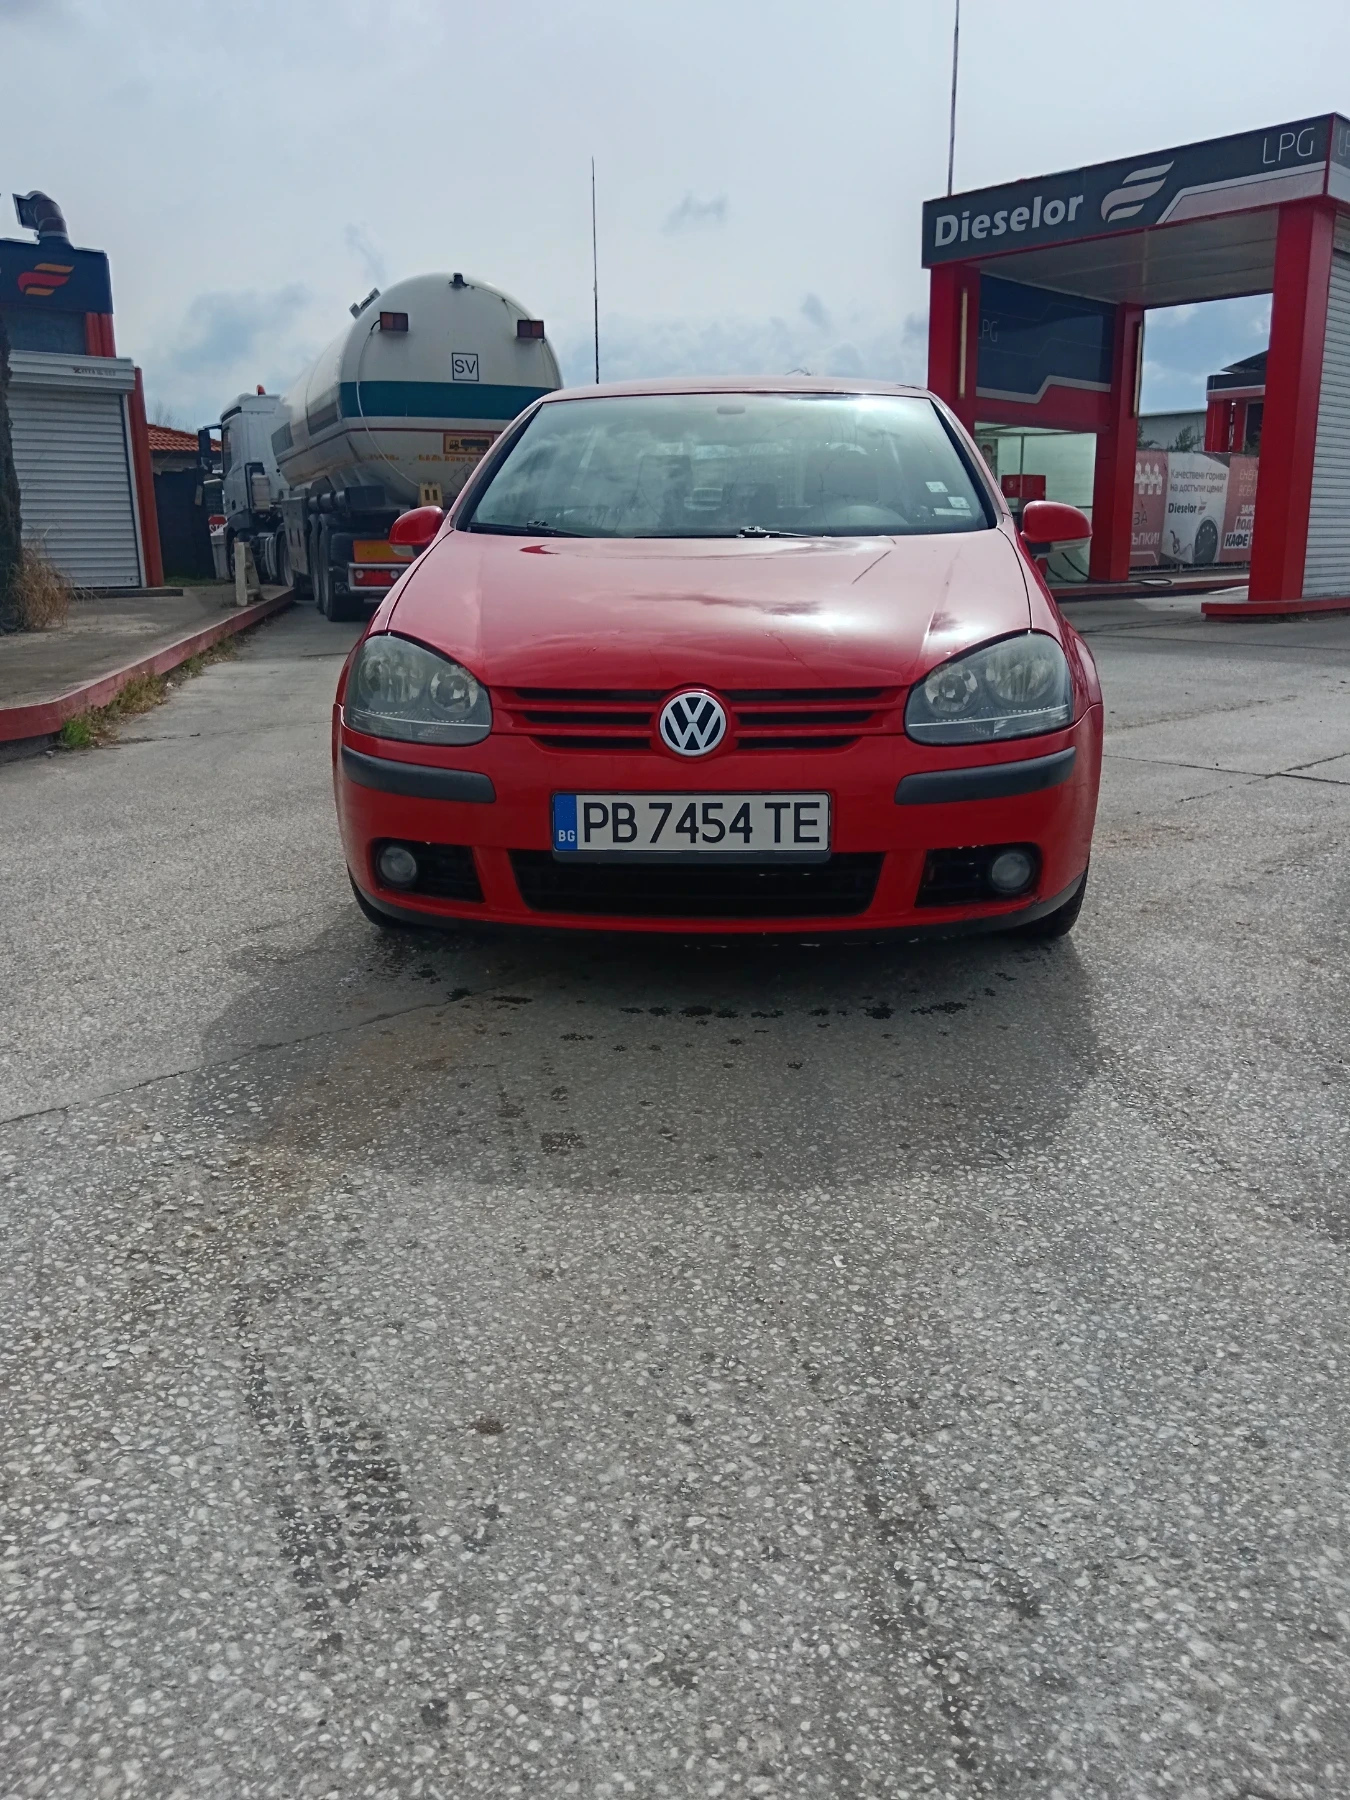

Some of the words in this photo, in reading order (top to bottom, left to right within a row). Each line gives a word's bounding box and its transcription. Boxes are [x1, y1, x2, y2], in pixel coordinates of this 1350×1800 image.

[1263, 127, 1315, 164] LPG
[1338, 127, 1350, 157] LP
[934, 195, 1084, 248] Dieselor
[978, 318, 998, 342] PG
[454, 359, 476, 374] SV
[1206, 472, 1226, 482] горива
[1133, 510, 1148, 525] ЗА
[1168, 502, 1197, 514] Dieselor
[1131, 532, 1160, 546] ЪПКИ!
[1225, 533, 1249, 547] КАФЕ
[661, 693, 725, 755] VW
[558, 830, 576, 842] BG
[583, 802, 638, 843] PB
[648, 802, 753, 843] 7454
[765, 802, 820, 843] TE
